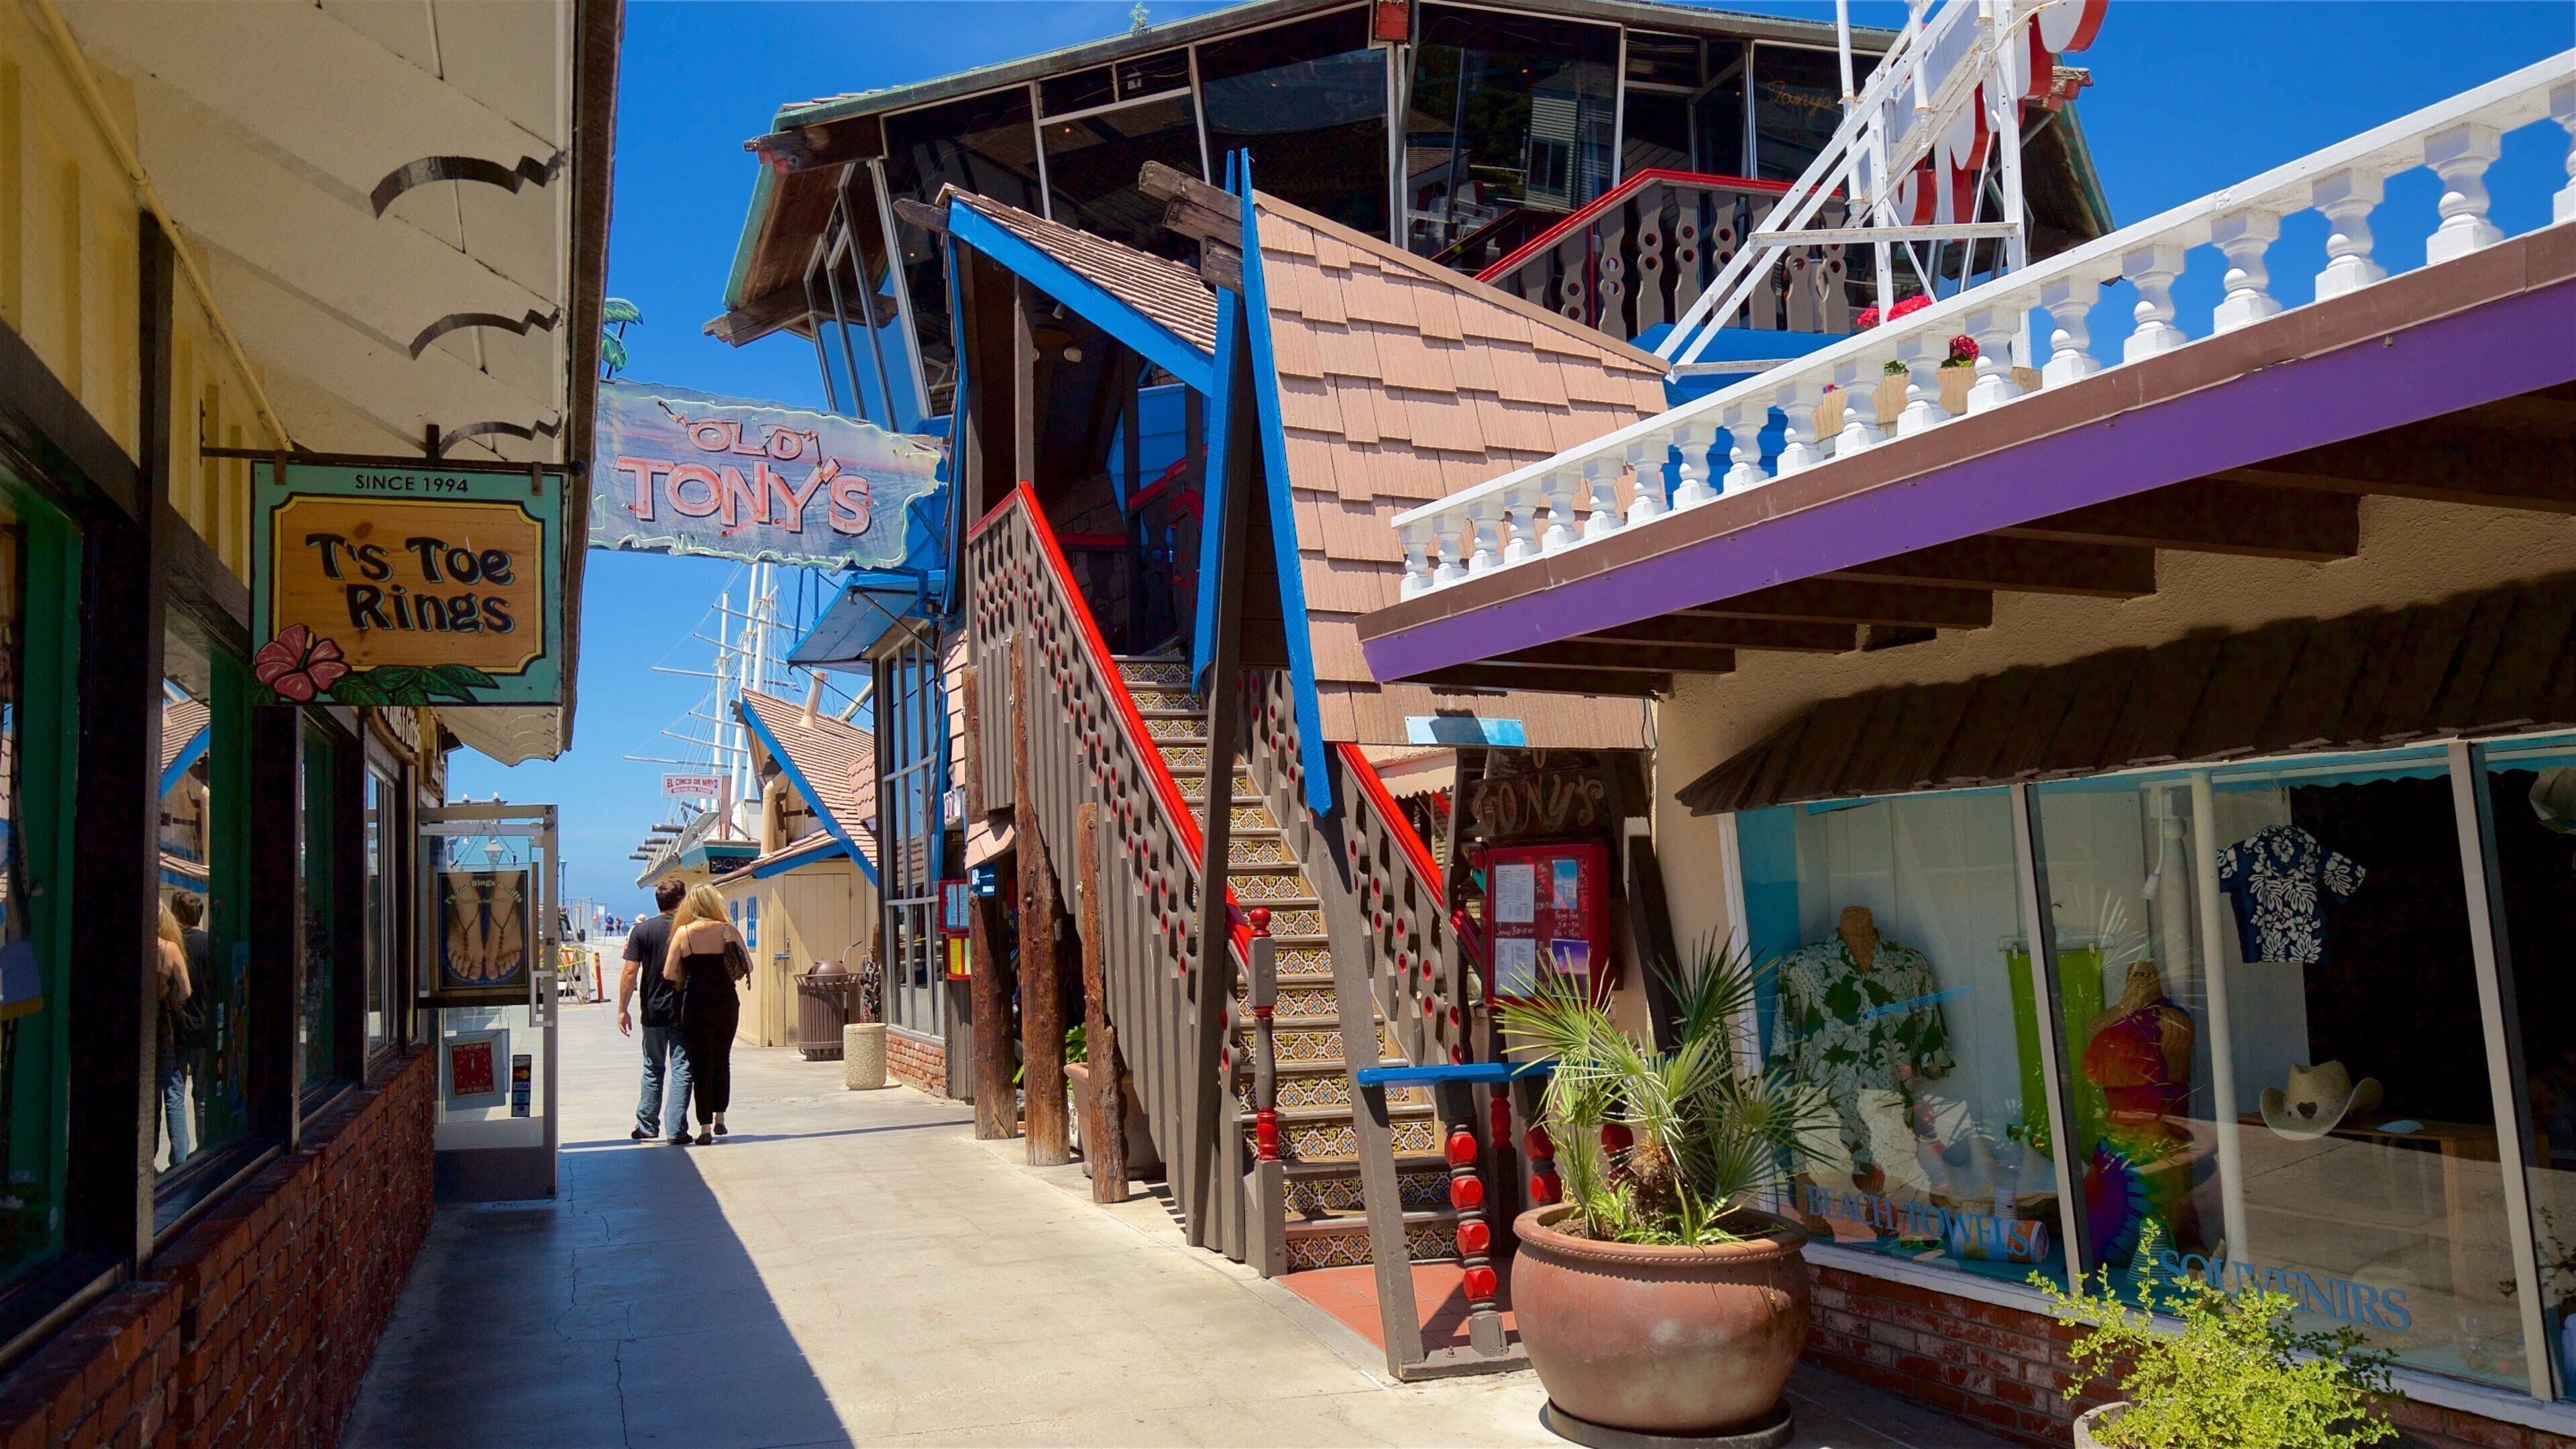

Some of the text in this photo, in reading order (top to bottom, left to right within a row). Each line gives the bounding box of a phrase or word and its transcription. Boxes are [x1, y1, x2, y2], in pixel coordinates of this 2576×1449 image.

[686, 417, 803, 461] OLD
[354, 473, 468, 493] SINCE 1994
[612, 453, 872, 537] TONY'S
[405, 535, 515, 586] Toe
[345, 584, 517, 634] Rings
[667, 778, 674, 788] EL
[702, 779, 718, 789] MAYO
[455, 884, 470, 895] Toe
[471, 879, 496, 888] Rings
[498, 881, 504, 889] &
[506, 885, 523, 903] Gifts
[1807, 1185, 2030, 1256] BEACH TOWELS
[2159, 1248, 2412, 1332] SOUVENIRS
